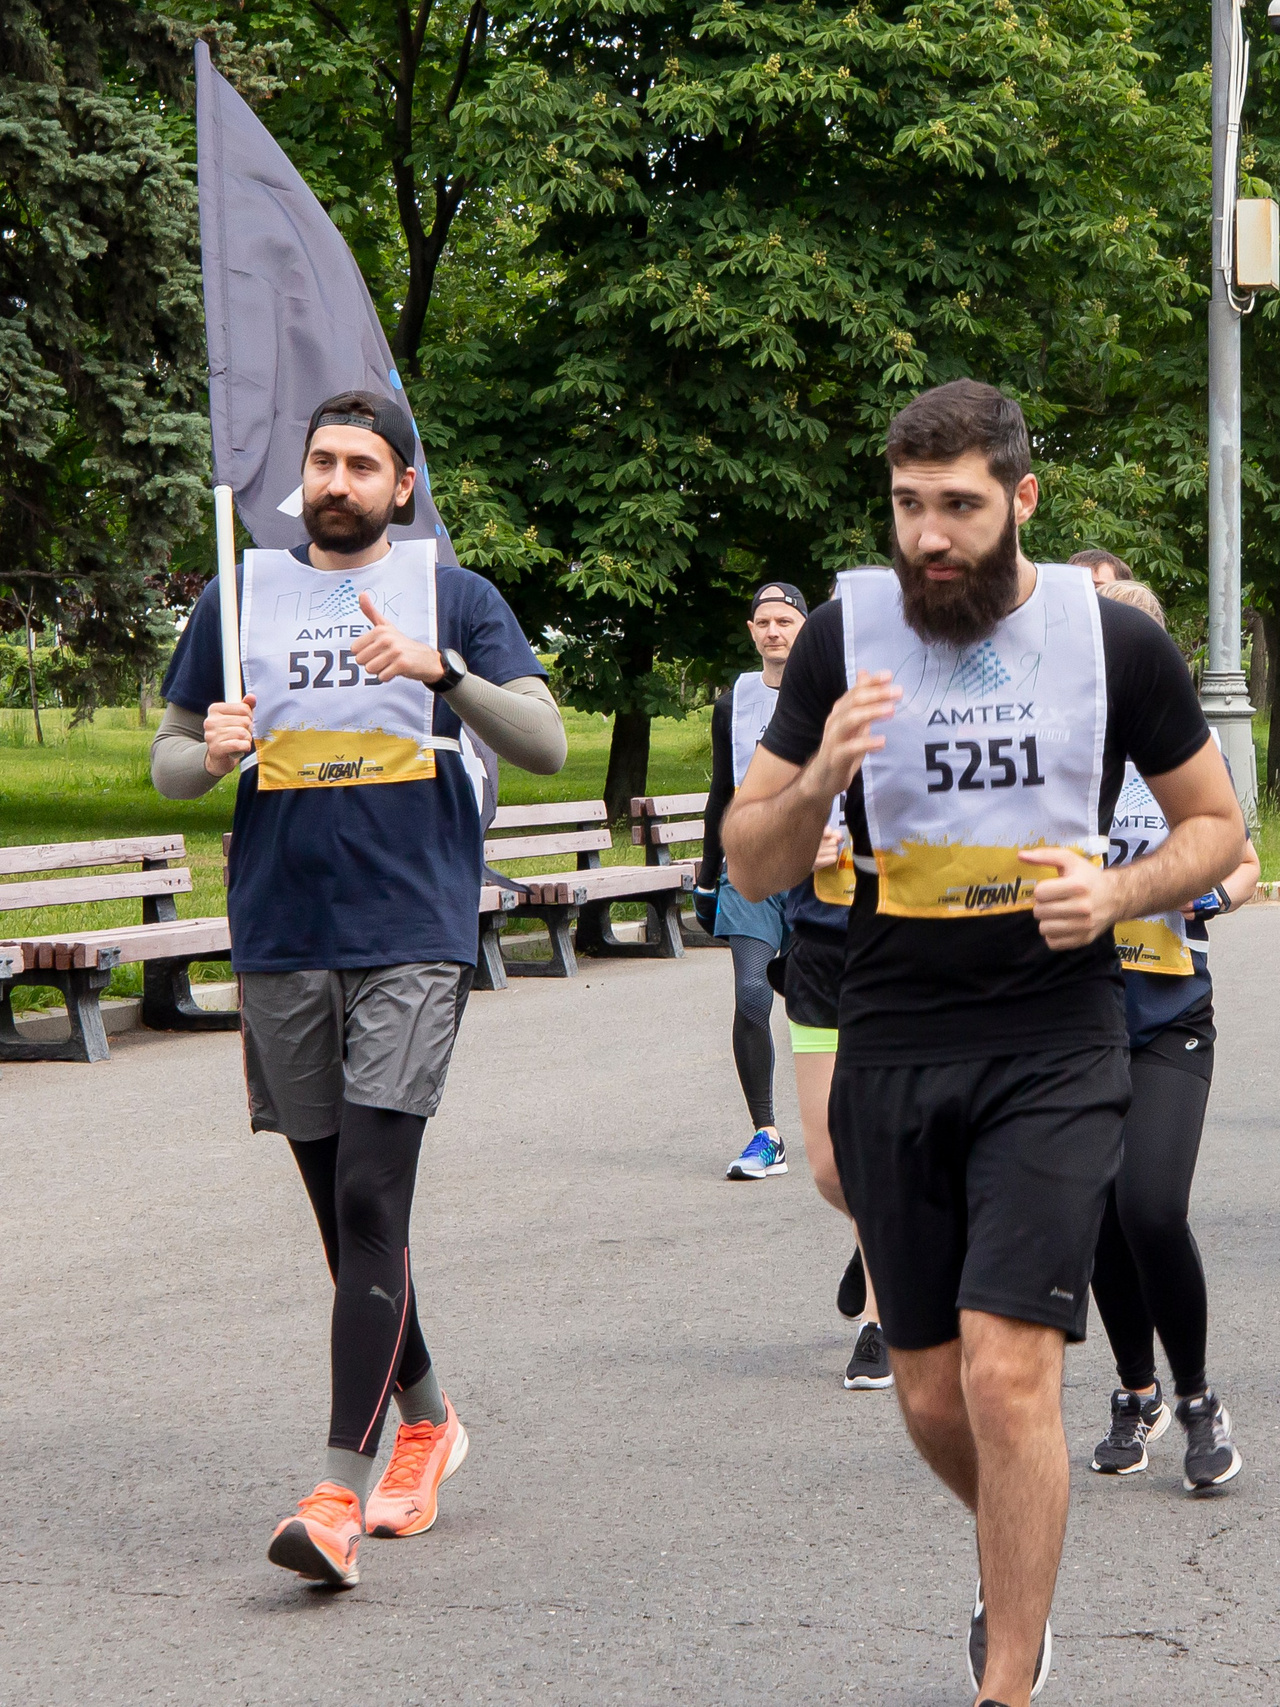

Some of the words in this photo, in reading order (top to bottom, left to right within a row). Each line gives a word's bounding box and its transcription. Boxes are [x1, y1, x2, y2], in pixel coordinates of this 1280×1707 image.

[295, 624, 373, 641] AMTE
[927, 700, 1036, 727] AMTEX
[318, 756, 364, 783] URBAN
[924, 735, 1046, 794] 5251
[1112, 815, 1169, 830] MTEX
[964, 874, 1022, 911] URBAN
